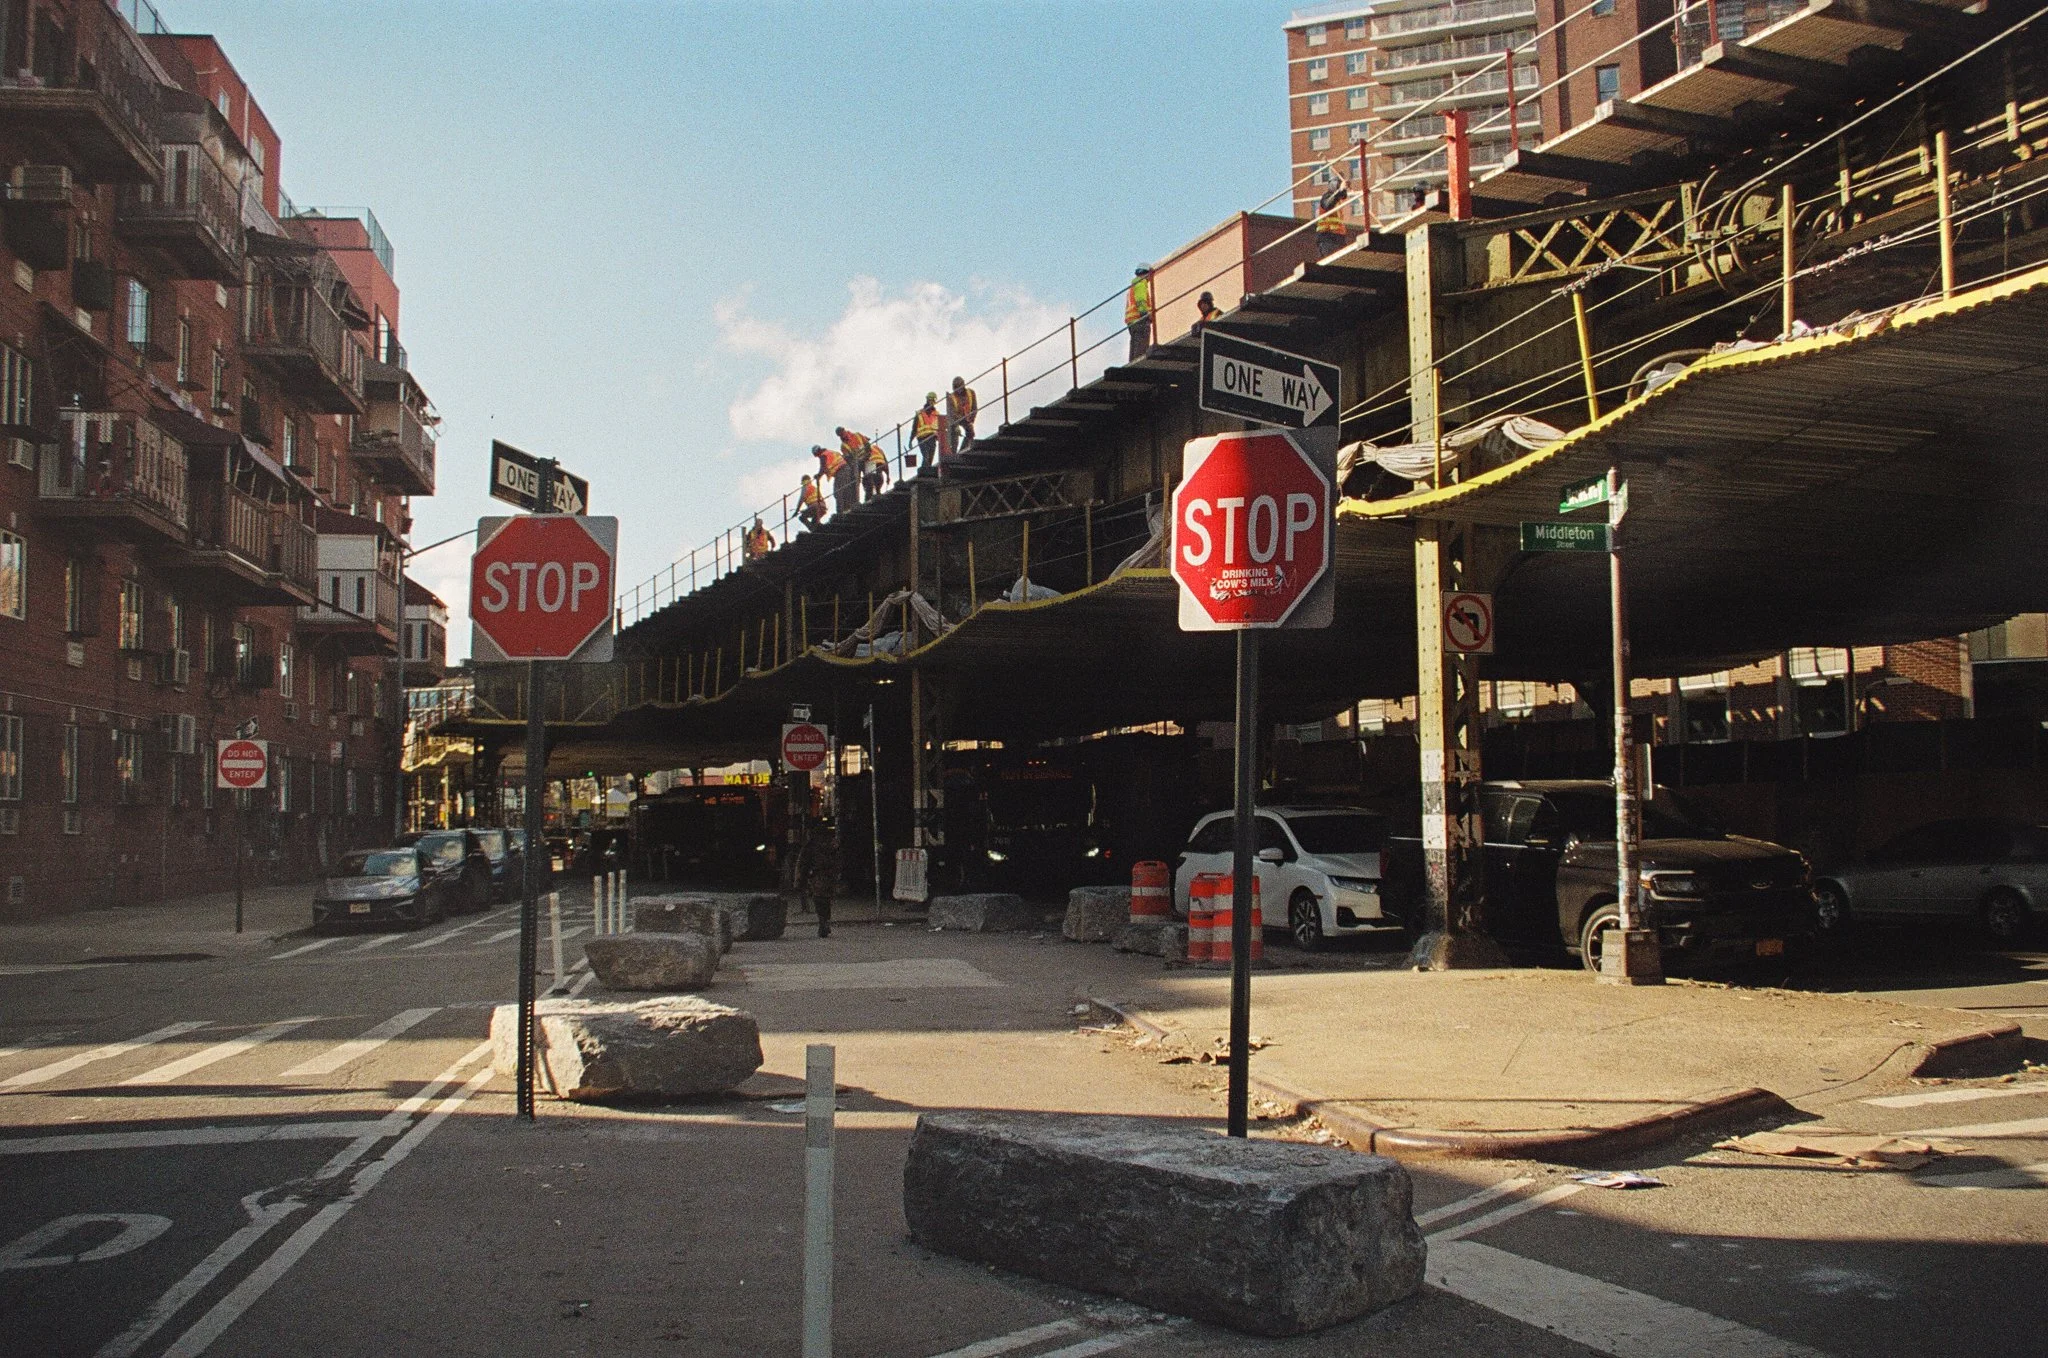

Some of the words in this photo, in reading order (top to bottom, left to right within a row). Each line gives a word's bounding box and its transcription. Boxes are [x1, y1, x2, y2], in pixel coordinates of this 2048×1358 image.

[1224, 361, 1263, 398] ONE
[1282, 376, 1321, 412] WAY
[506, 464, 536, 495] ONE
[1182, 492, 1318, 567] STOP
[1535, 524, 1595, 540] Middleton
[1556, 540, 1576, 549] Street
[1222, 568, 1268, 579] DRINKING
[481, 561, 600, 613] STOP
[1216, 578, 1248, 589] COW'S
[1250, 577, 1274, 588] MILK
[791, 733, 802, 741] DO
[804, 733, 819, 741] NOT
[227, 750, 239, 758] DO
[242, 750, 258, 758] NOT
[793, 753, 818, 762] ENTER
